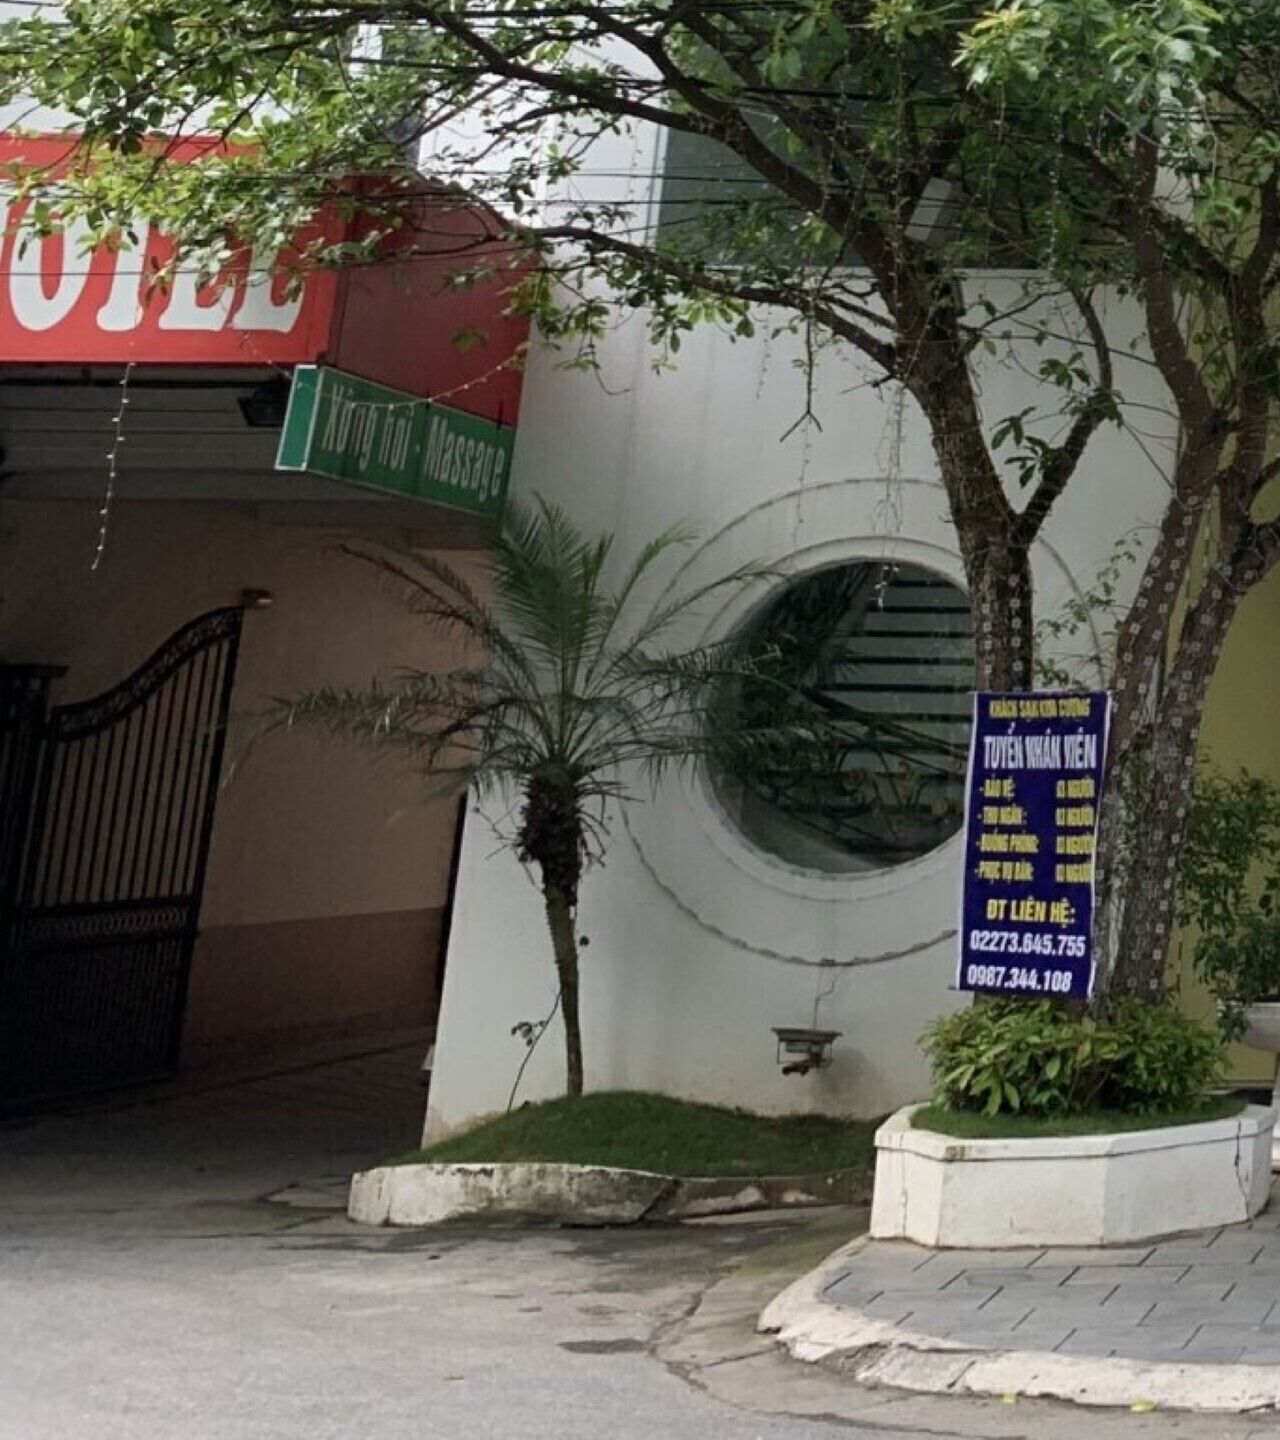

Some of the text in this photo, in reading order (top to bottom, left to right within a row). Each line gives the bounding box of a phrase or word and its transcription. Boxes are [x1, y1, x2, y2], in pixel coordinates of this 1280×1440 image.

[0, 179, 306, 333] OTEL
[423, 415, 506, 503] Massage
[1010, 895, 1047, 922] LIÊN
[969, 929, 1086, 958] 02273.645.755
[966, 964, 1073, 993] 0987.344.108
